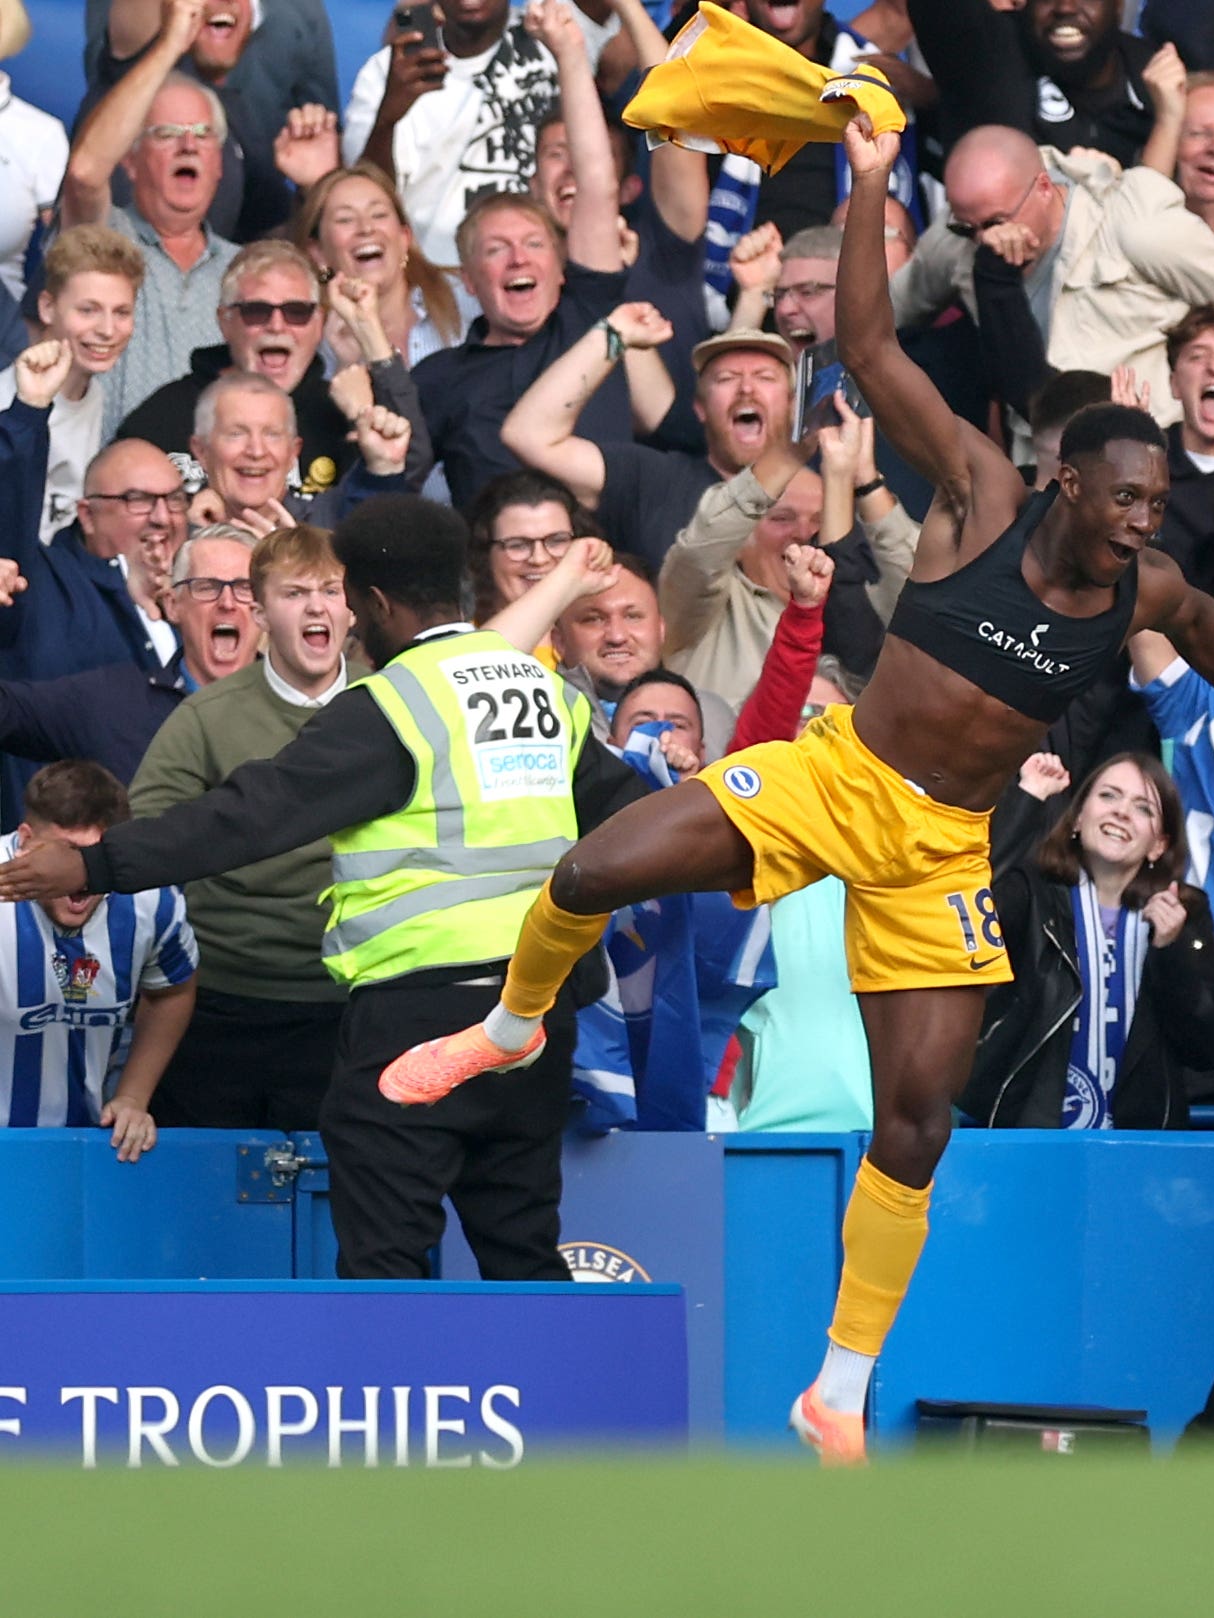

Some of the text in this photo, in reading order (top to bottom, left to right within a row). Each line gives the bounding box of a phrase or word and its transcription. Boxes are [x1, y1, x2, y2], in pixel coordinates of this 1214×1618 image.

[452, 662, 546, 685] STEWARD
[978, 621, 1070, 675] CATAPULT
[466, 687, 561, 744] 228
[489, 752, 558, 773] seroca
[944, 886, 1006, 954] 18
[562, 1249, 636, 1284] ELSEA
[61, 1385, 525, 1468] TROPHIES
